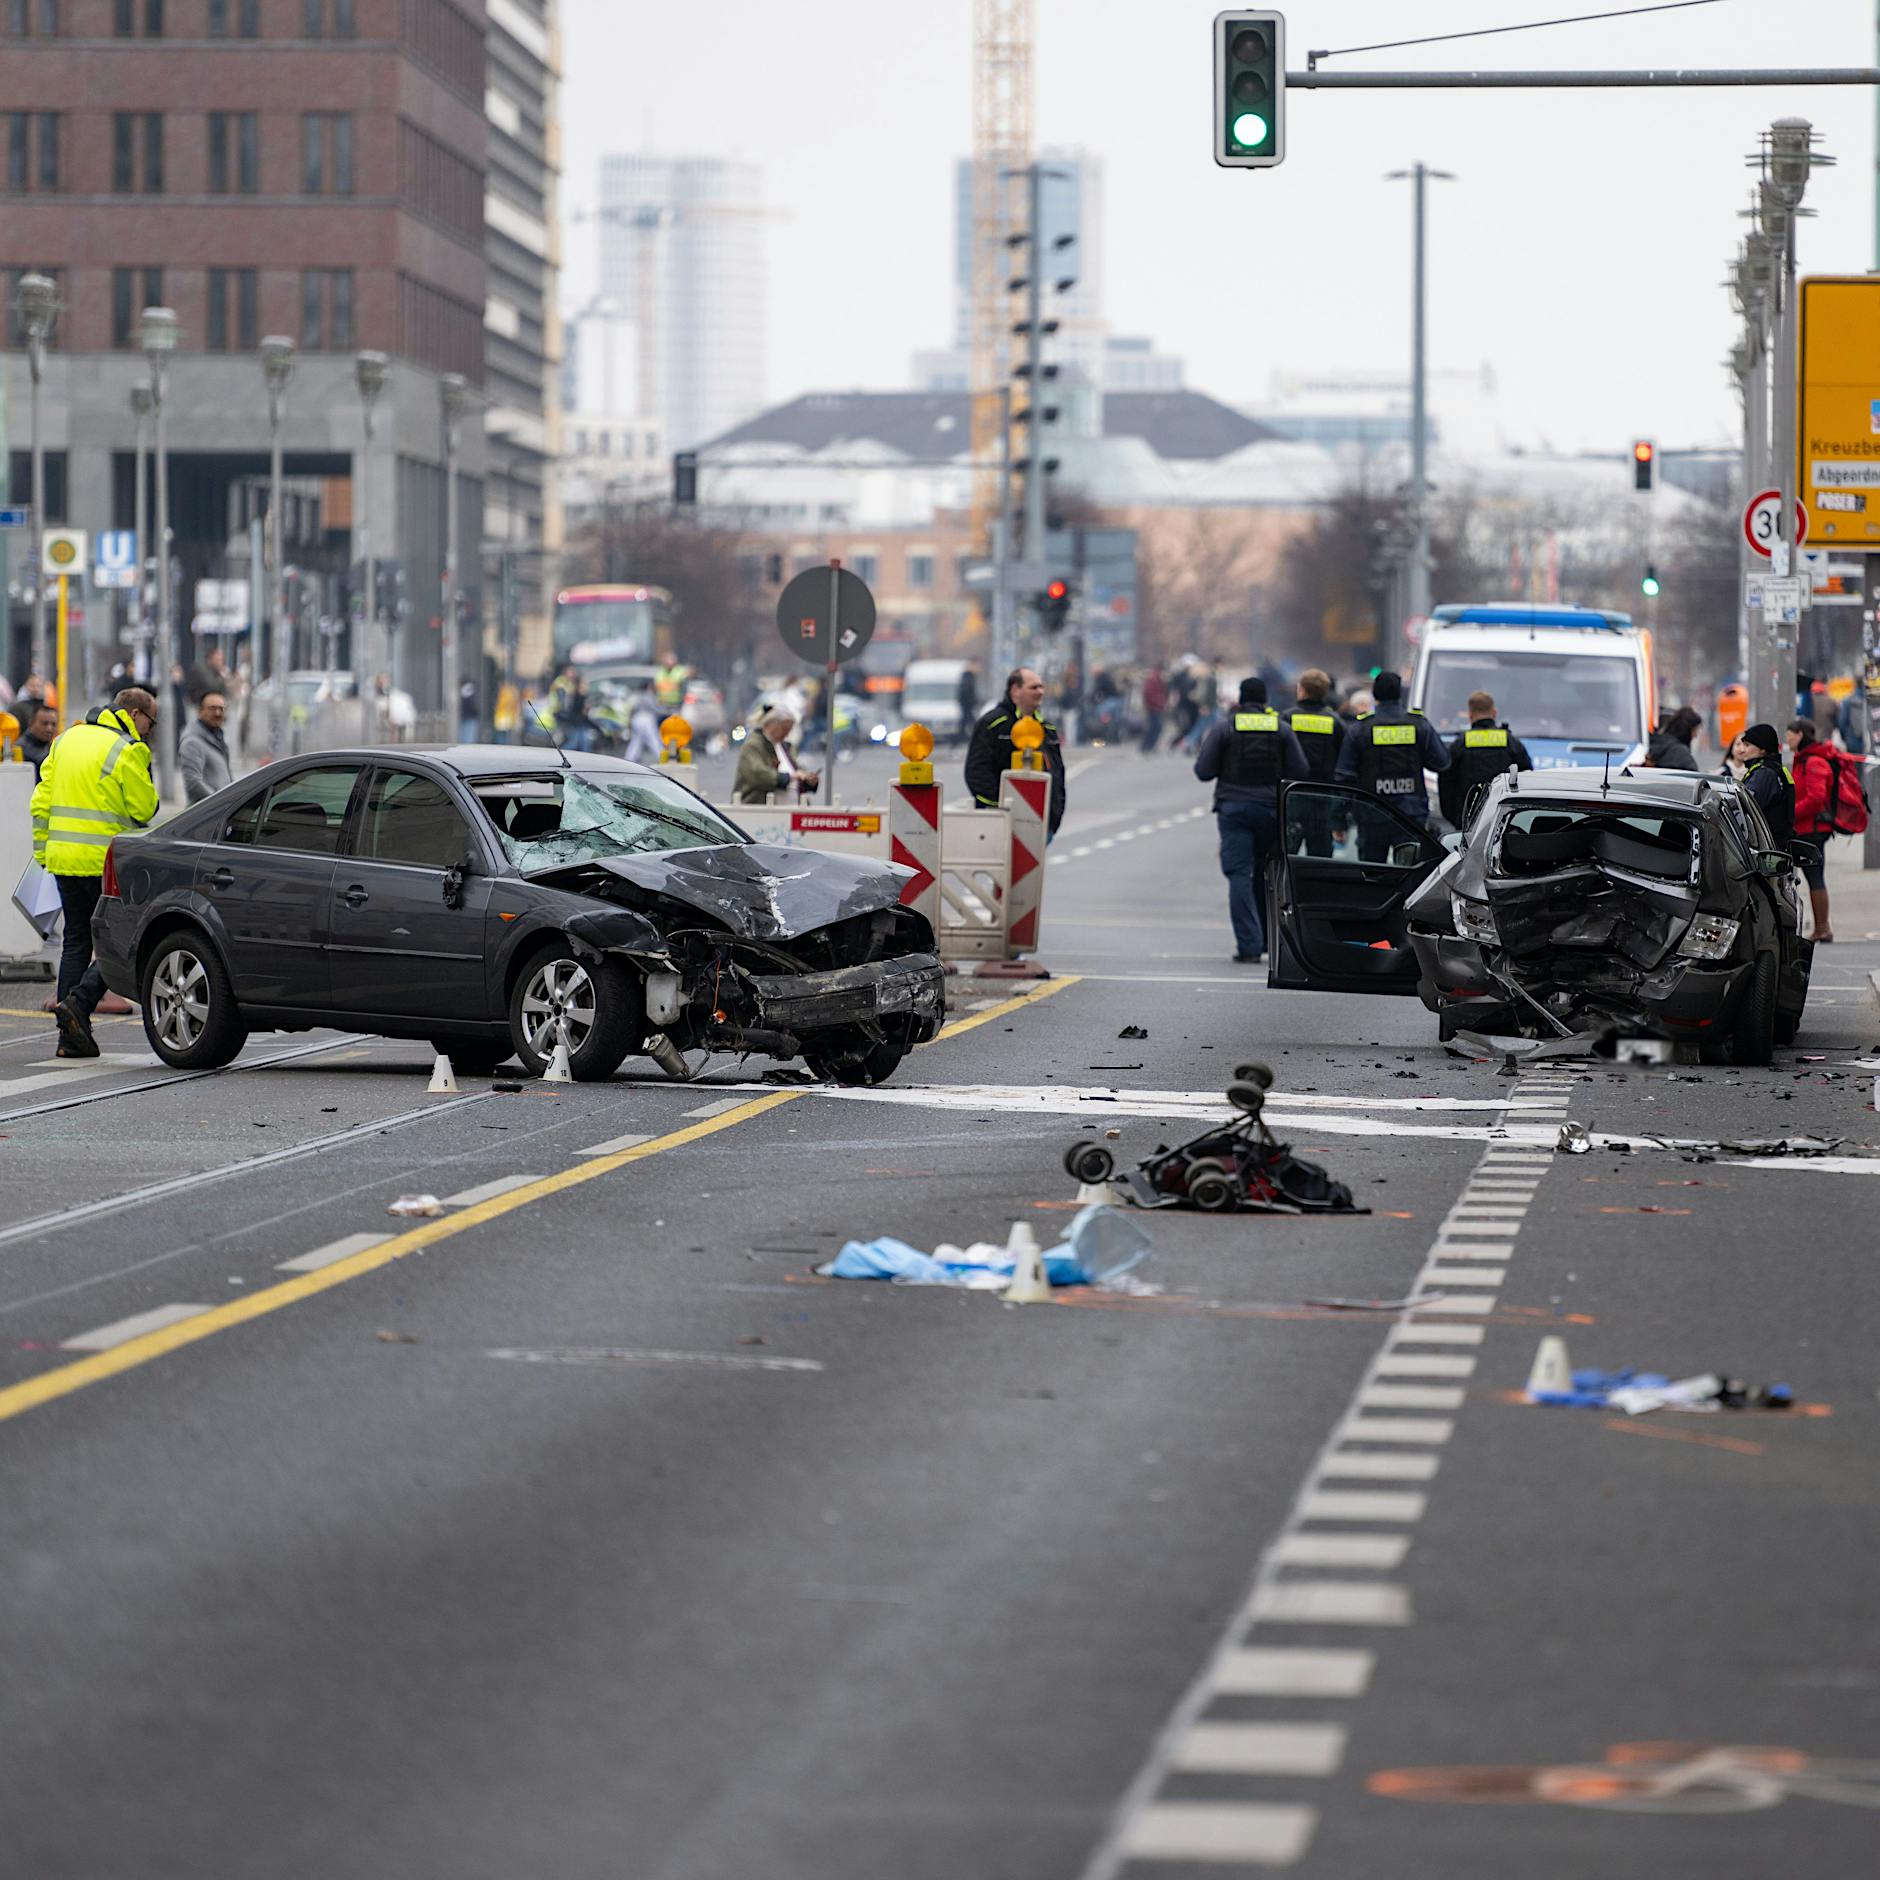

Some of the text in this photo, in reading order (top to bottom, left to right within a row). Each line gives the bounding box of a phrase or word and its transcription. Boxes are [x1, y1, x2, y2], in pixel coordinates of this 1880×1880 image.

[1817, 467, 1880, 486] Abgeordn
[1758, 510, 1781, 539] 3
[102, 531, 130, 569] U
[1375, 727, 1415, 742] POLIZEI
[1376, 778, 1415, 794] POLIZEI
[800, 816, 849, 828] ZEPPELIN
[443, 1079, 448, 1087] 9
